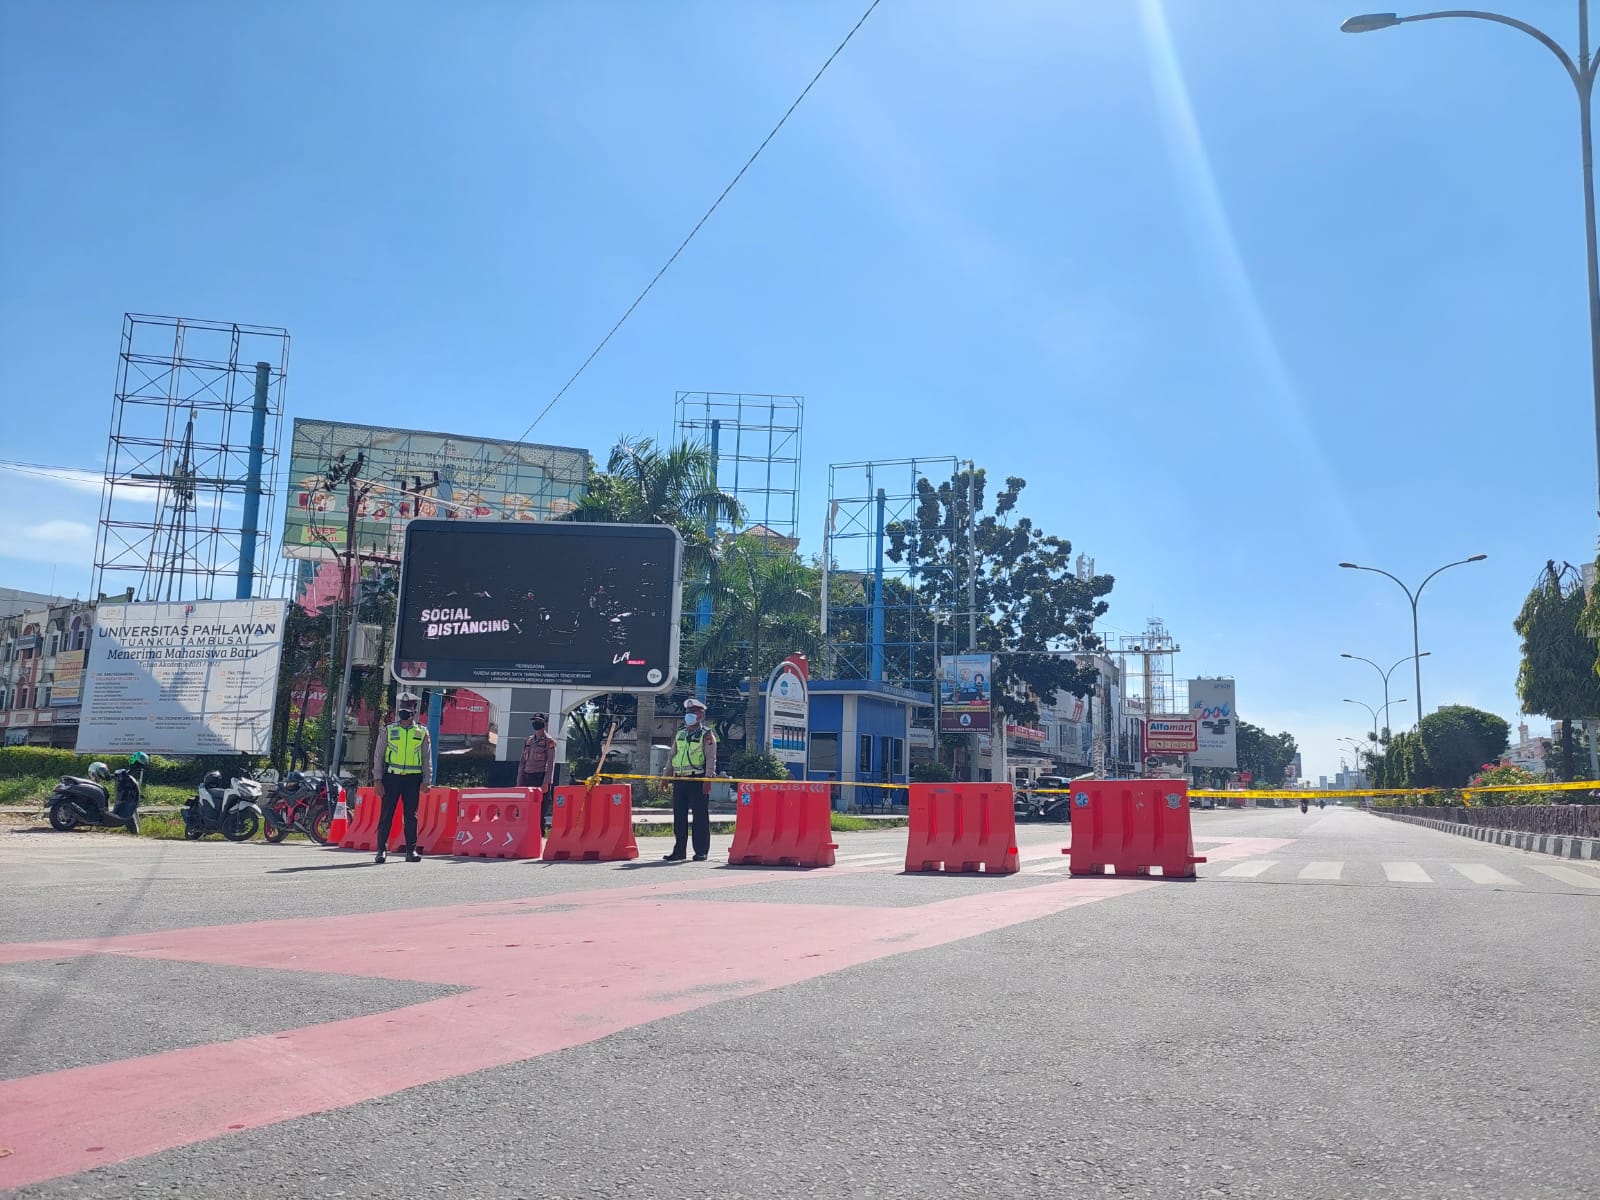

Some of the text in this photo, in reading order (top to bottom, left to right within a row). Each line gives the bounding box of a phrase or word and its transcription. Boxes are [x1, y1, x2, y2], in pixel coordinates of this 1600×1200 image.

[420, 608, 472, 621] SOCIAL
[99, 623, 276, 638] UNIVERSITAS PAHLAWAN
[427, 619, 510, 637] DISTANCING
[120, 636, 249, 647] TUANKU TAMBUSAI
[107, 647, 258, 660] Menerima Mahasiswa Baru
[1150, 723, 1193, 731] Alfamart
[760, 783, 807, 791] POLISI
